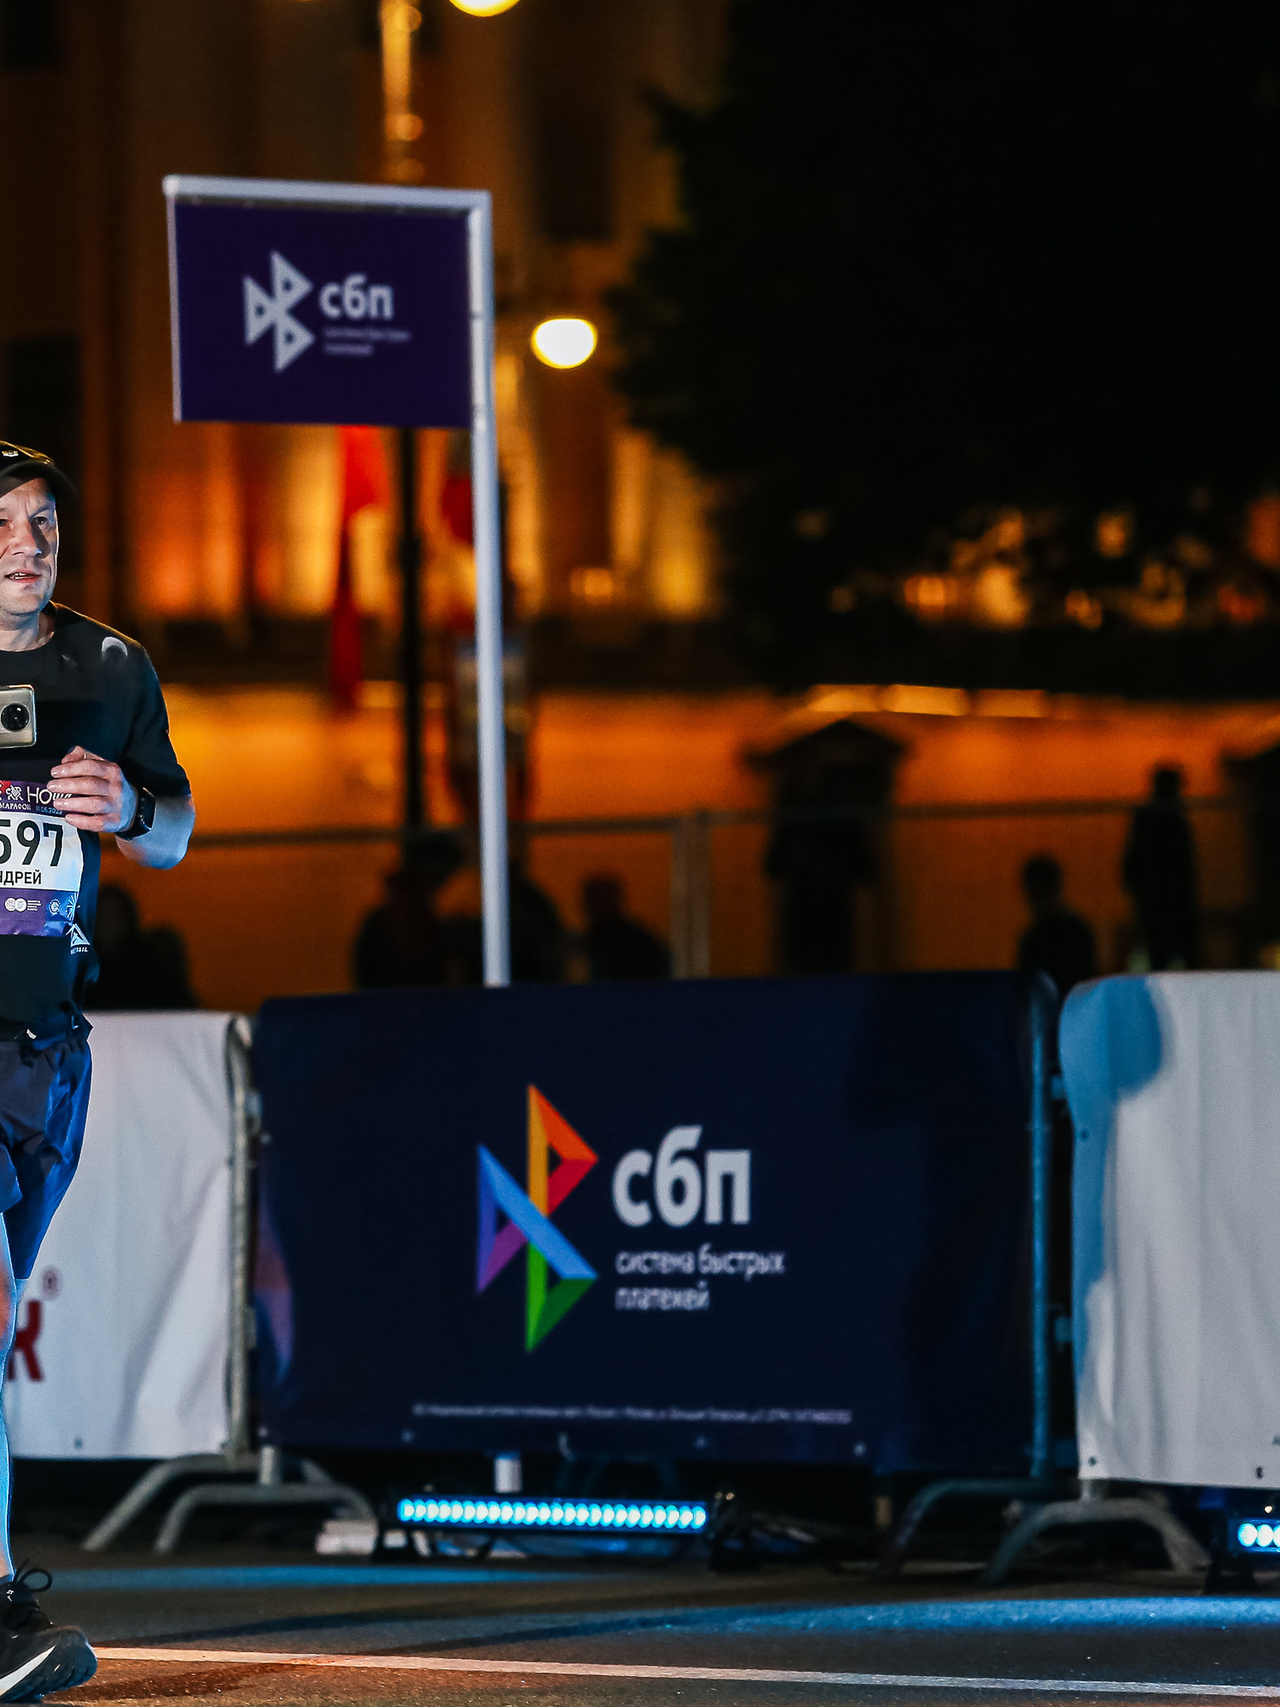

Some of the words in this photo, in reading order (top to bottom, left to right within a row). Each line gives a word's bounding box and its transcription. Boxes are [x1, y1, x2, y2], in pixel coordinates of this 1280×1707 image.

[320, 273, 393, 320] сбп
[613, 1125, 751, 1227] сбп
[615, 1251, 695, 1274] система
[698, 1243, 785, 1281] быстрых
[615, 1279, 709, 1311] платежей
